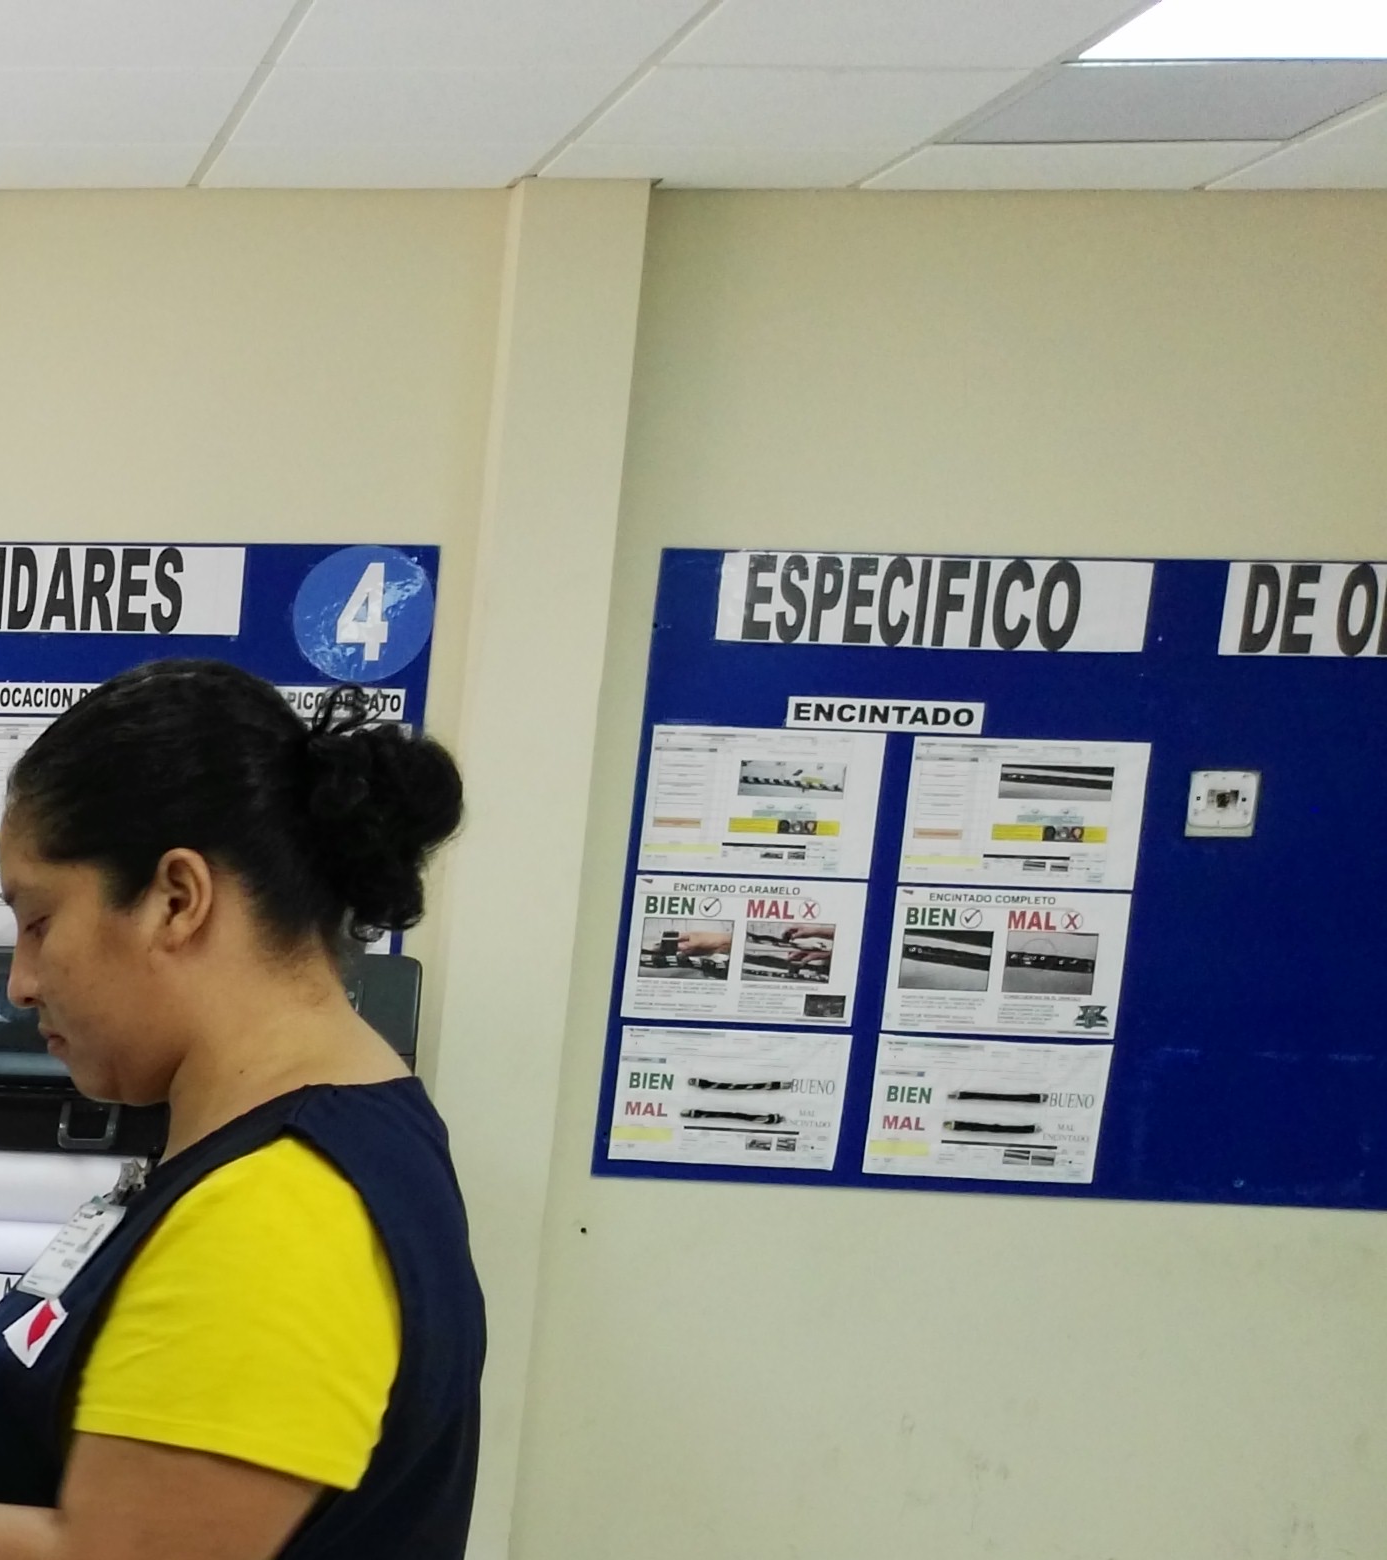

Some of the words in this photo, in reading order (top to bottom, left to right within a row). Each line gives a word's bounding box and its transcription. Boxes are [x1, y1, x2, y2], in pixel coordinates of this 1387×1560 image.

[336, 561, 390, 662] 4
[741, 553, 1082, 651] ESPECIFICO
[1238, 563, 1322, 654] DE
[793, 701, 976, 728] ENCINTADO
[673, 882, 736, 894] ENCINTADO
[739, 884, 801, 896] CARAMELO
[929, 892, 992, 904] ENCINTADO
[994, 894, 1057, 906] COMPLETO
[644, 896, 695, 916] BIEN
[746, 899, 795, 920] MAL
[905, 907, 956, 927] BIEN
[1007, 910, 1056, 930] MAL
[629, 1072, 674, 1090] BIEN
[790, 1078, 835, 1095] BUENO
[886, 1085, 932, 1104] BIEN
[1049, 1092, 1094, 1109] BUENO
[625, 1101, 668, 1117] MAL
[882, 1115, 926, 1131] MAL
